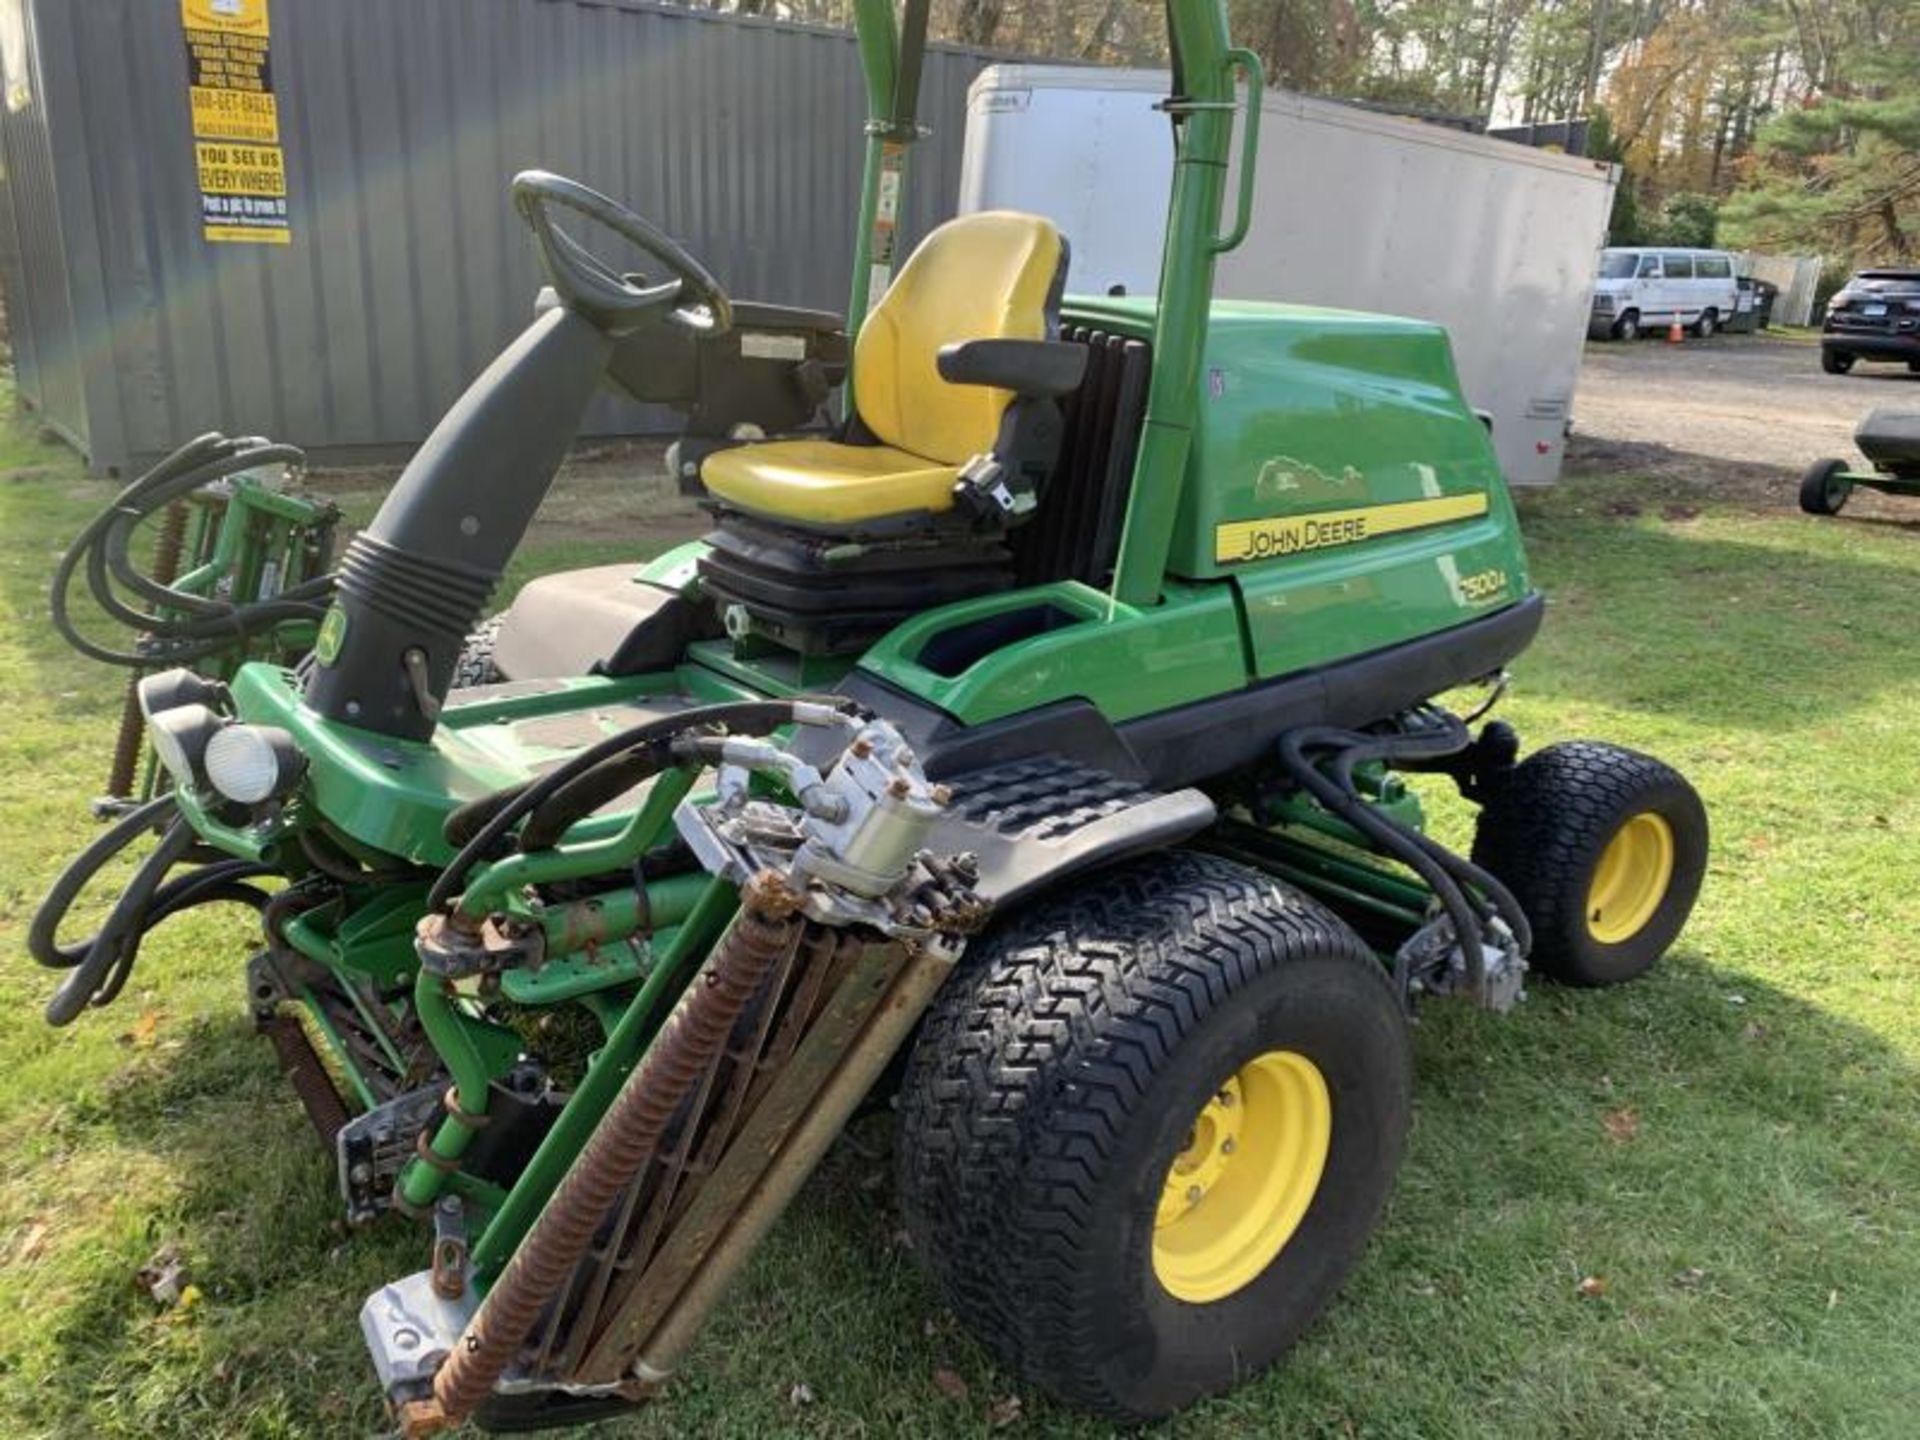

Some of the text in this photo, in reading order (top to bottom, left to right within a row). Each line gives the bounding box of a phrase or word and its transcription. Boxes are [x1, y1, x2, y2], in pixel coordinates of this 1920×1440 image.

[200, 148, 280, 168] YOU SEE US
[1242, 517, 1367, 555] JOHN DEERE
